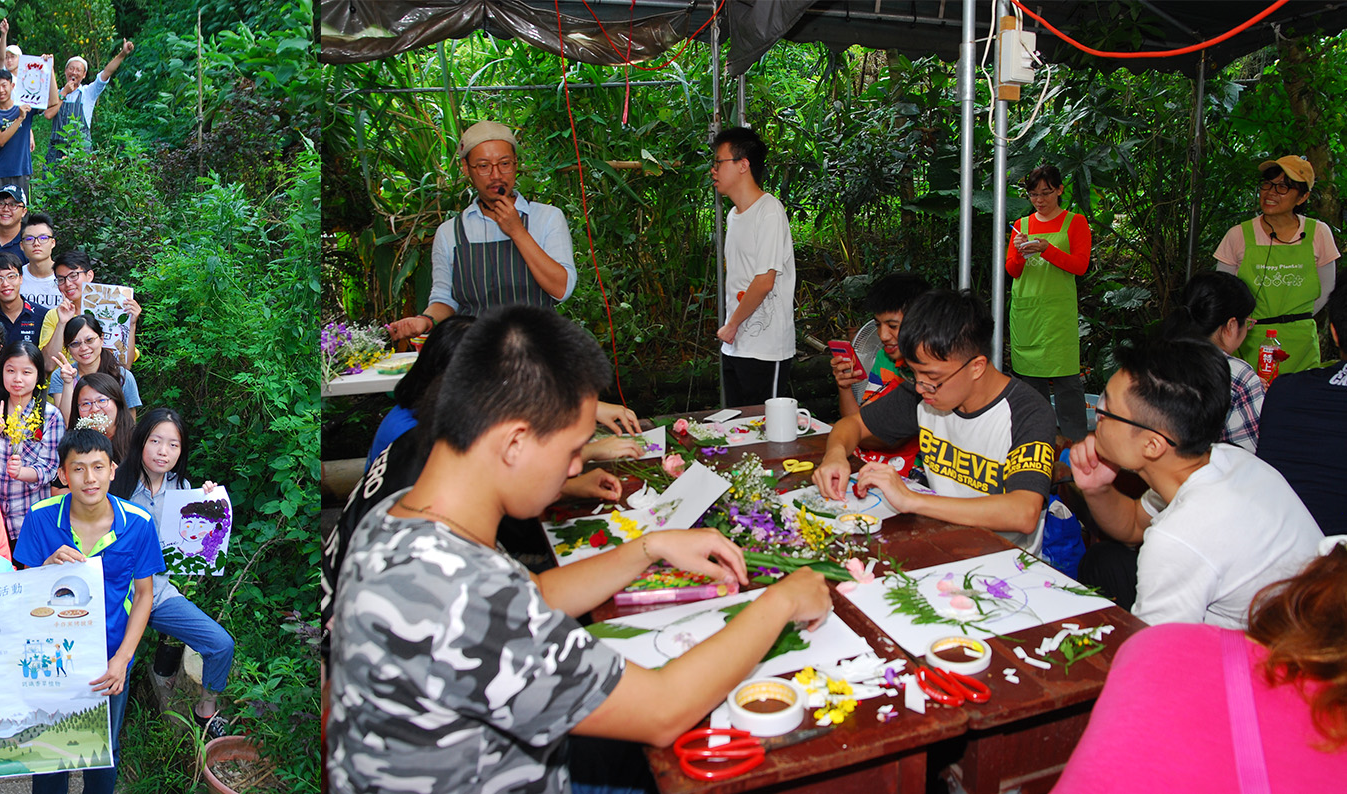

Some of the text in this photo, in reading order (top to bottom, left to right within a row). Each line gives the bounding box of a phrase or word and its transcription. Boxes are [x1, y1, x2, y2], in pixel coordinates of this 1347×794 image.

[919, 429, 999, 487] BELIEVE
[940, 466, 958, 479] AND
[957, 474, 989, 492] STRAPS
